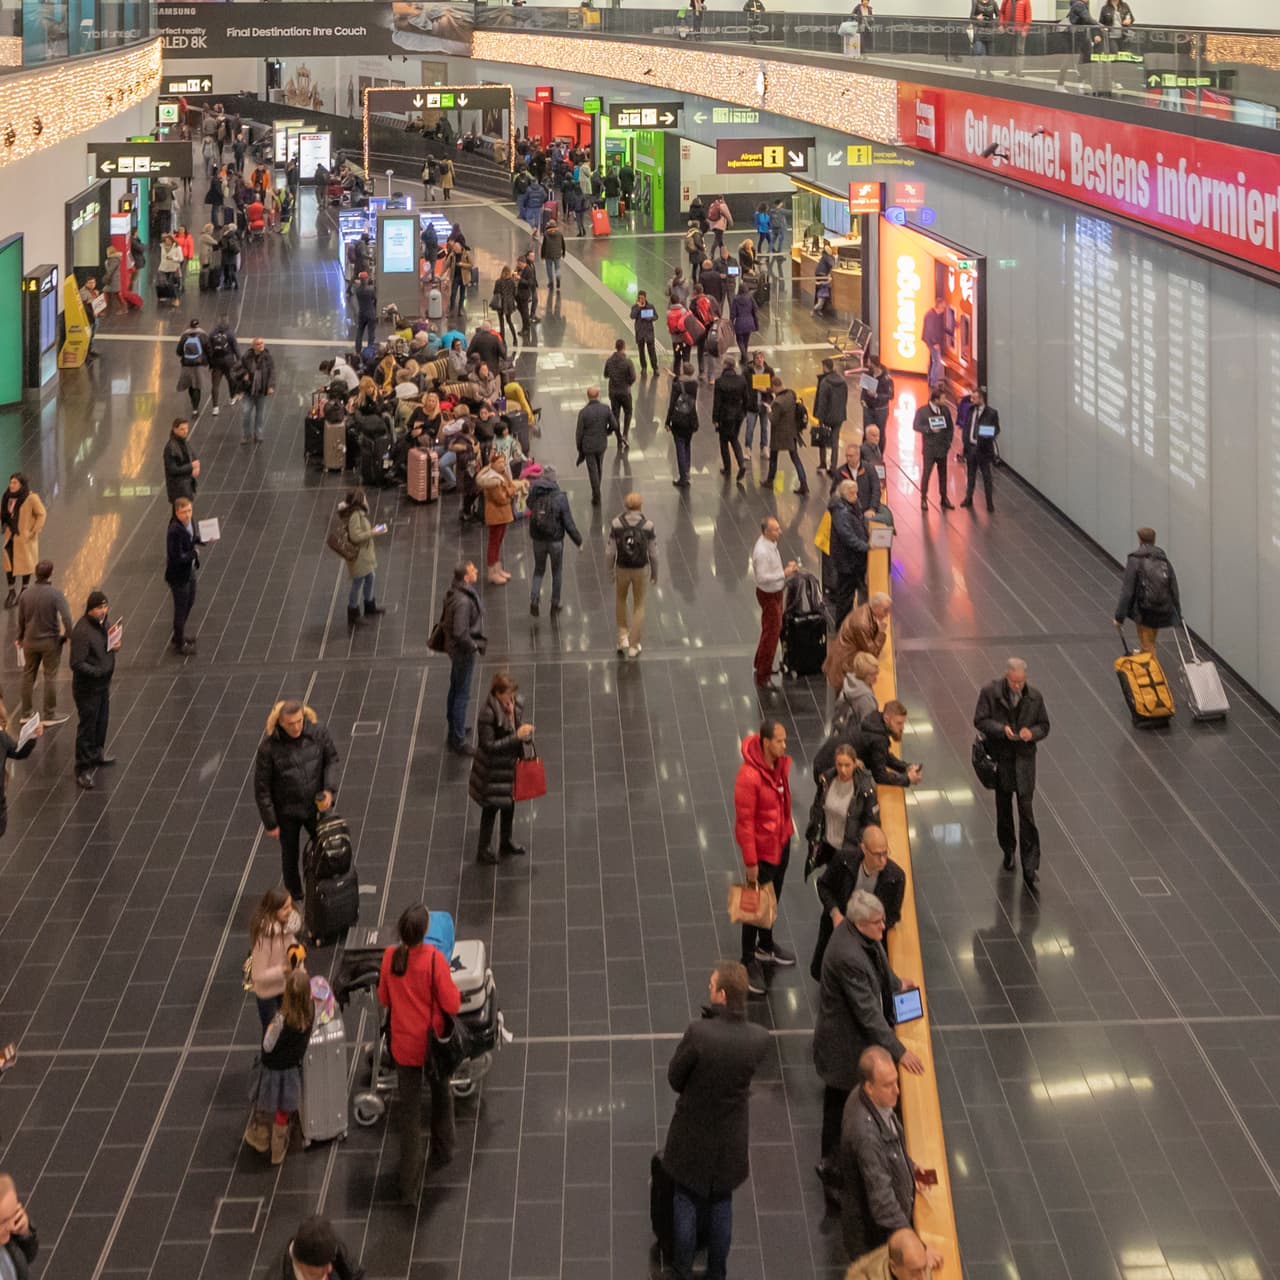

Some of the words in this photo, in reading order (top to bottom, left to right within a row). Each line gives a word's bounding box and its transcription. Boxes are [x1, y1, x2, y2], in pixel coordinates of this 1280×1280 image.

[182, 27, 207, 36] reality
[227, 27, 250, 37] Final
[252, 26, 312, 37] Destination:
[313, 25, 332, 36] Ihre
[334, 25, 367, 36] Couch
[191, 36, 208, 49] 8K
[1070, 131, 1151, 210] Bestens
